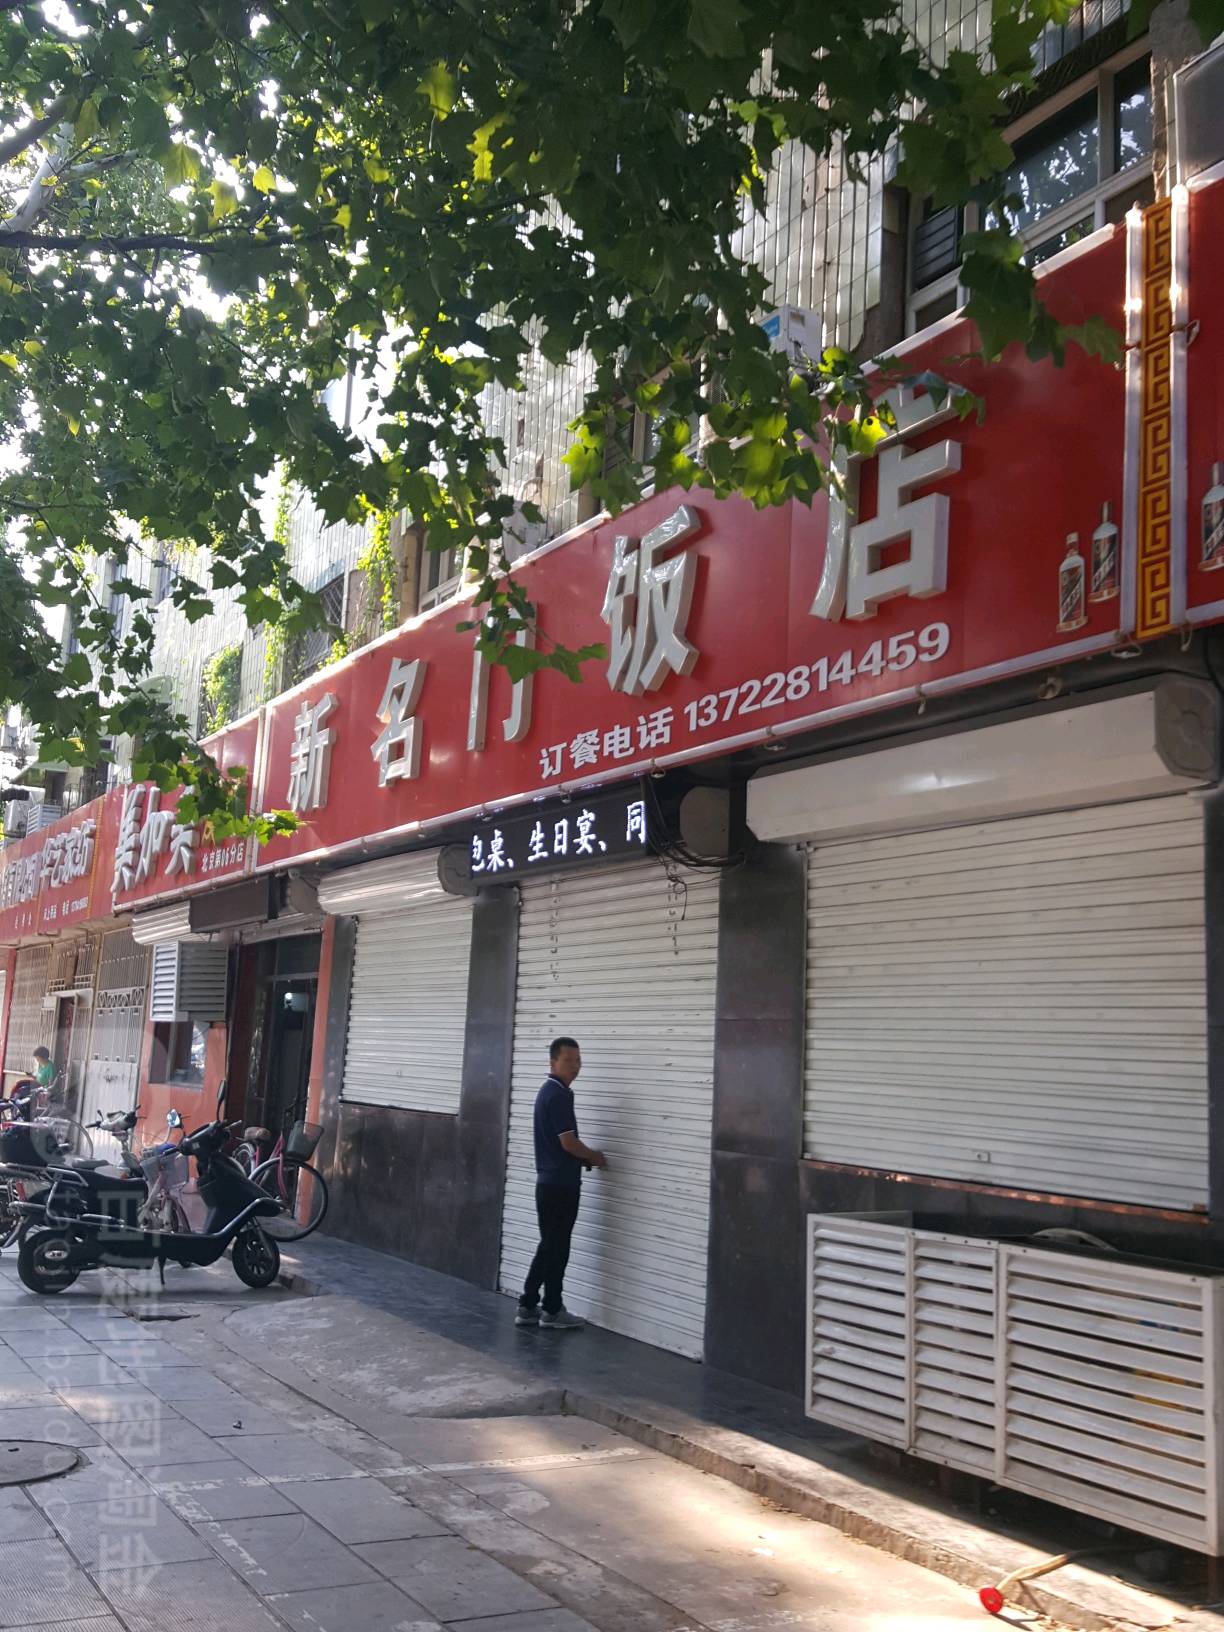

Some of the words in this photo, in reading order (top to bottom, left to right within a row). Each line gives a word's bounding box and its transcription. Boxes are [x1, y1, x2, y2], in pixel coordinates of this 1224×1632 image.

[285, 383, 962, 812] 新名门饭店
[538, 706, 675, 780] 订餐电话
[683, 621, 951, 733] 13722814459
